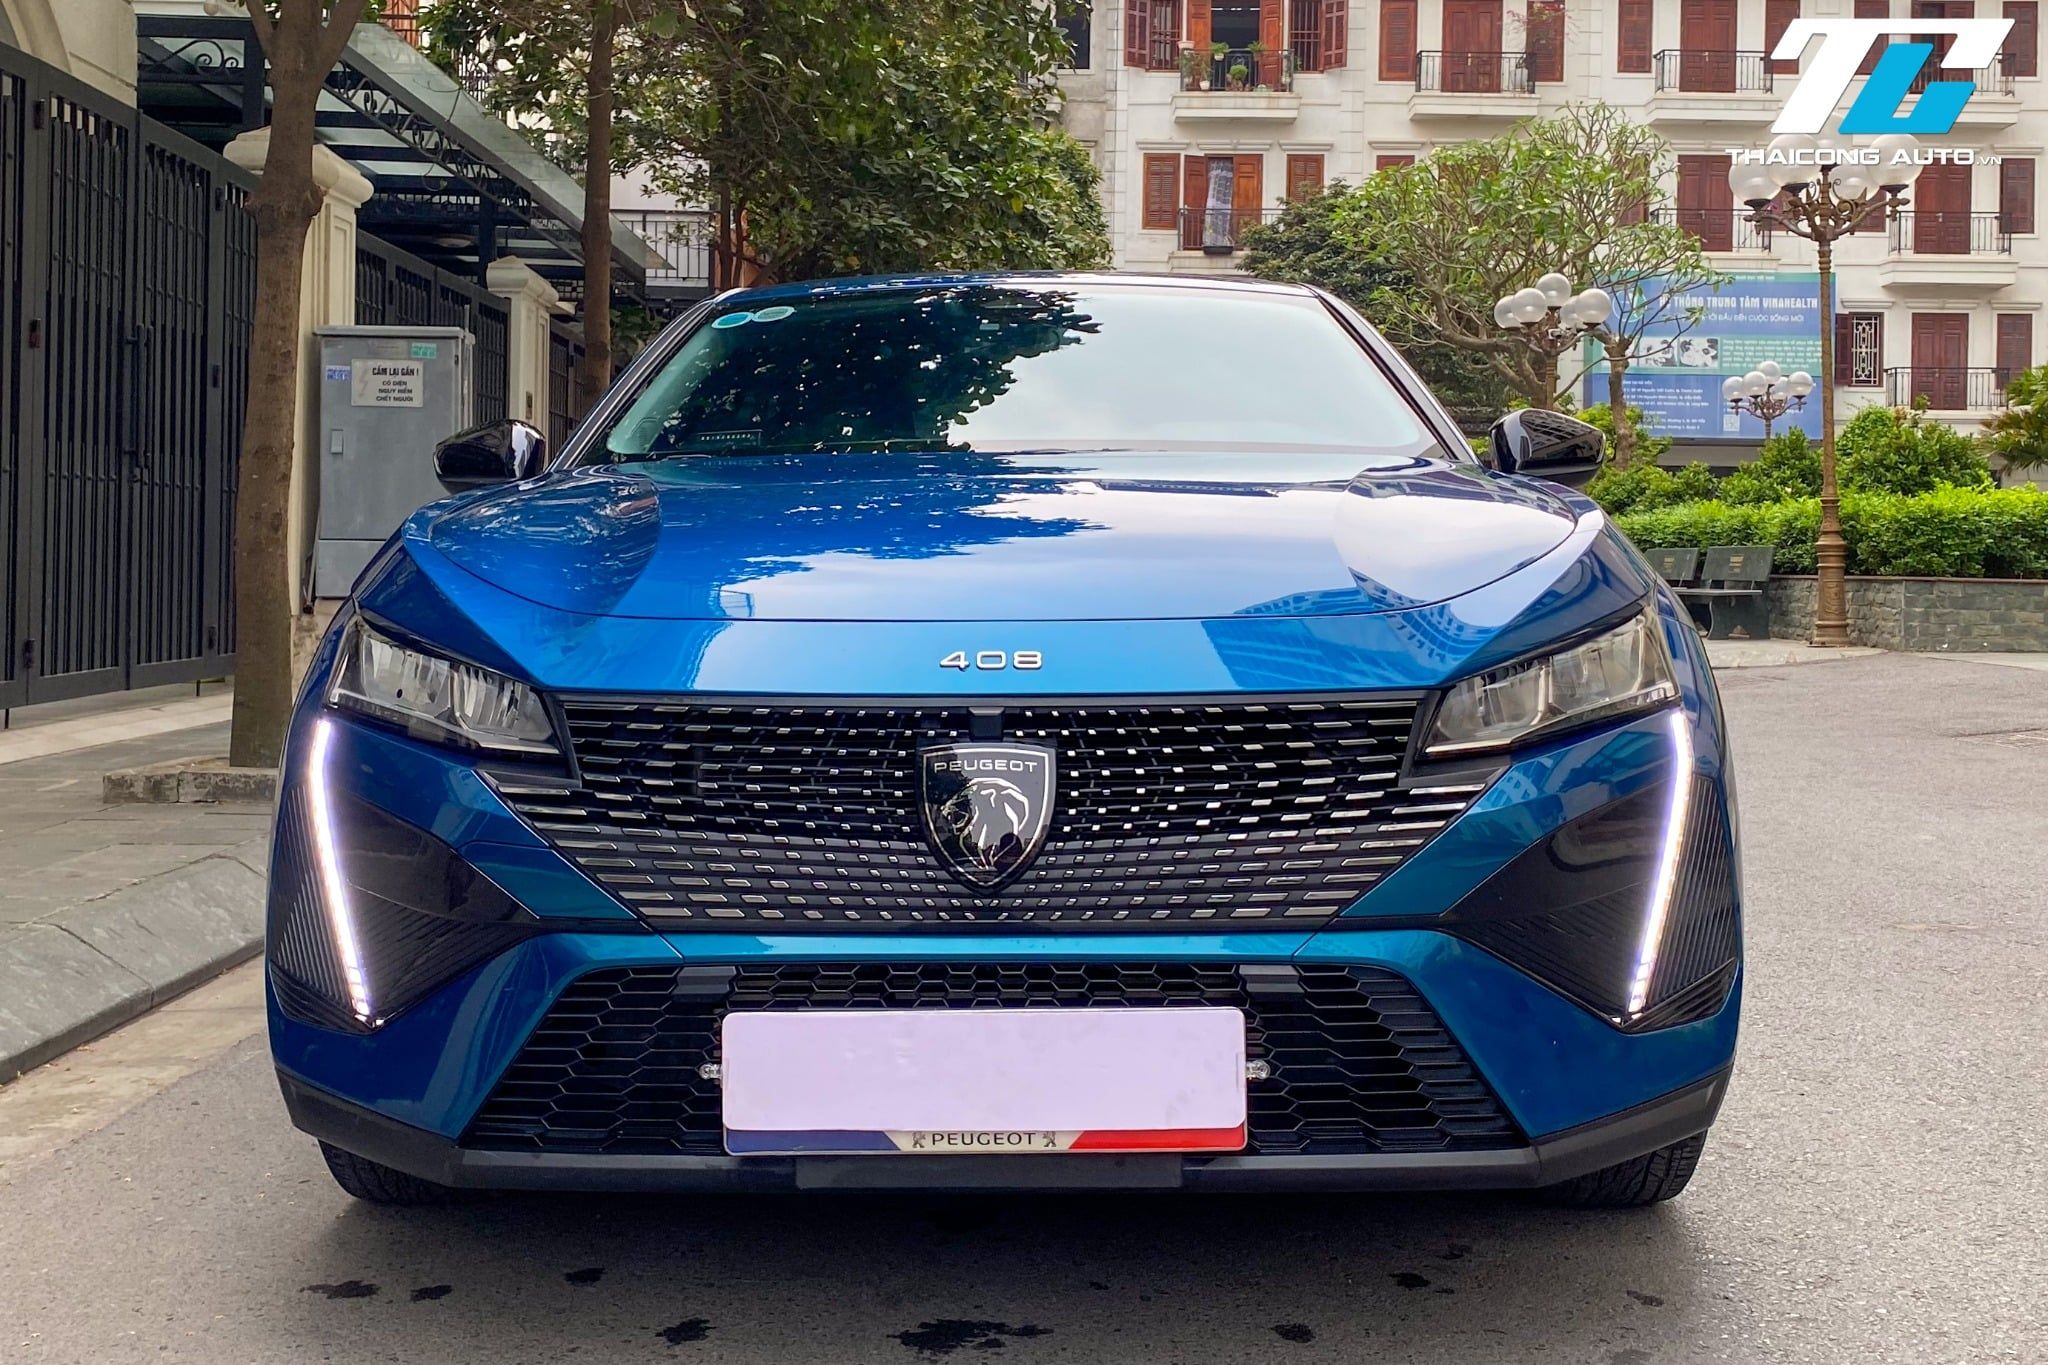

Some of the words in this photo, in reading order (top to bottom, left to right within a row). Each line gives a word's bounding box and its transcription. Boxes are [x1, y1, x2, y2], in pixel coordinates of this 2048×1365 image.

[1706, 296, 1737, 308] TRUNG
[1739, 295, 1760, 308] TÂM
[1762, 296, 1818, 308] VINAHEALTH
[940, 650, 1043, 671] 408
[934, 759, 1038, 773] PEUGEOT
[932, 1132, 1036, 1145] PEUGEOT
